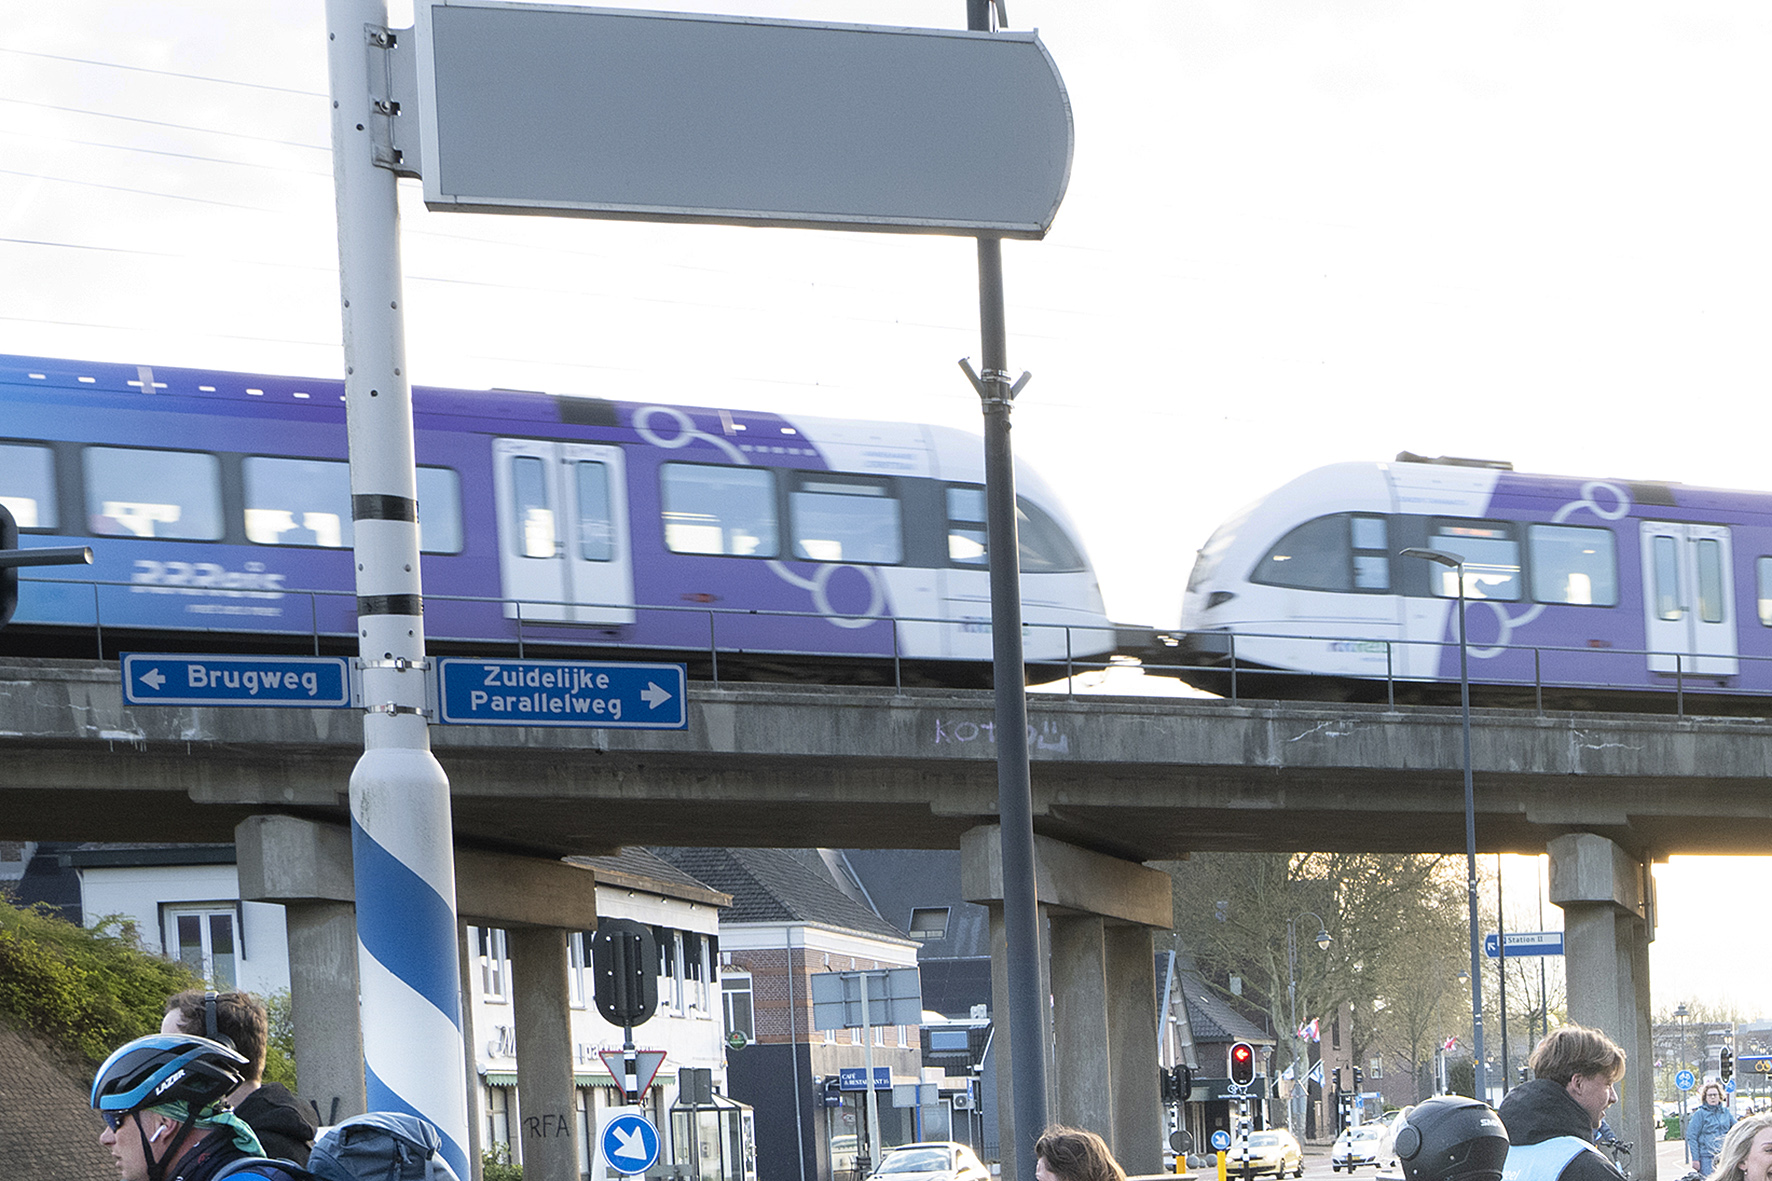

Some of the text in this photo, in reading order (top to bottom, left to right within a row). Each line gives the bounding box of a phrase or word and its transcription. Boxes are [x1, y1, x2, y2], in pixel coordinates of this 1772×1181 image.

[187, 664, 318, 696] Brugweg
[483, 665, 609, 695] Zuidelijke
[470, 690, 622, 720] Parallelweg
[1507, 936, 1535, 944] Station
[155, 1068, 187, 1096] LAZER
[841, 1072, 857, 1080] CAFÉ
[524, 1114, 570, 1139] RFA
[1502, 1169, 1522, 1181] eel
